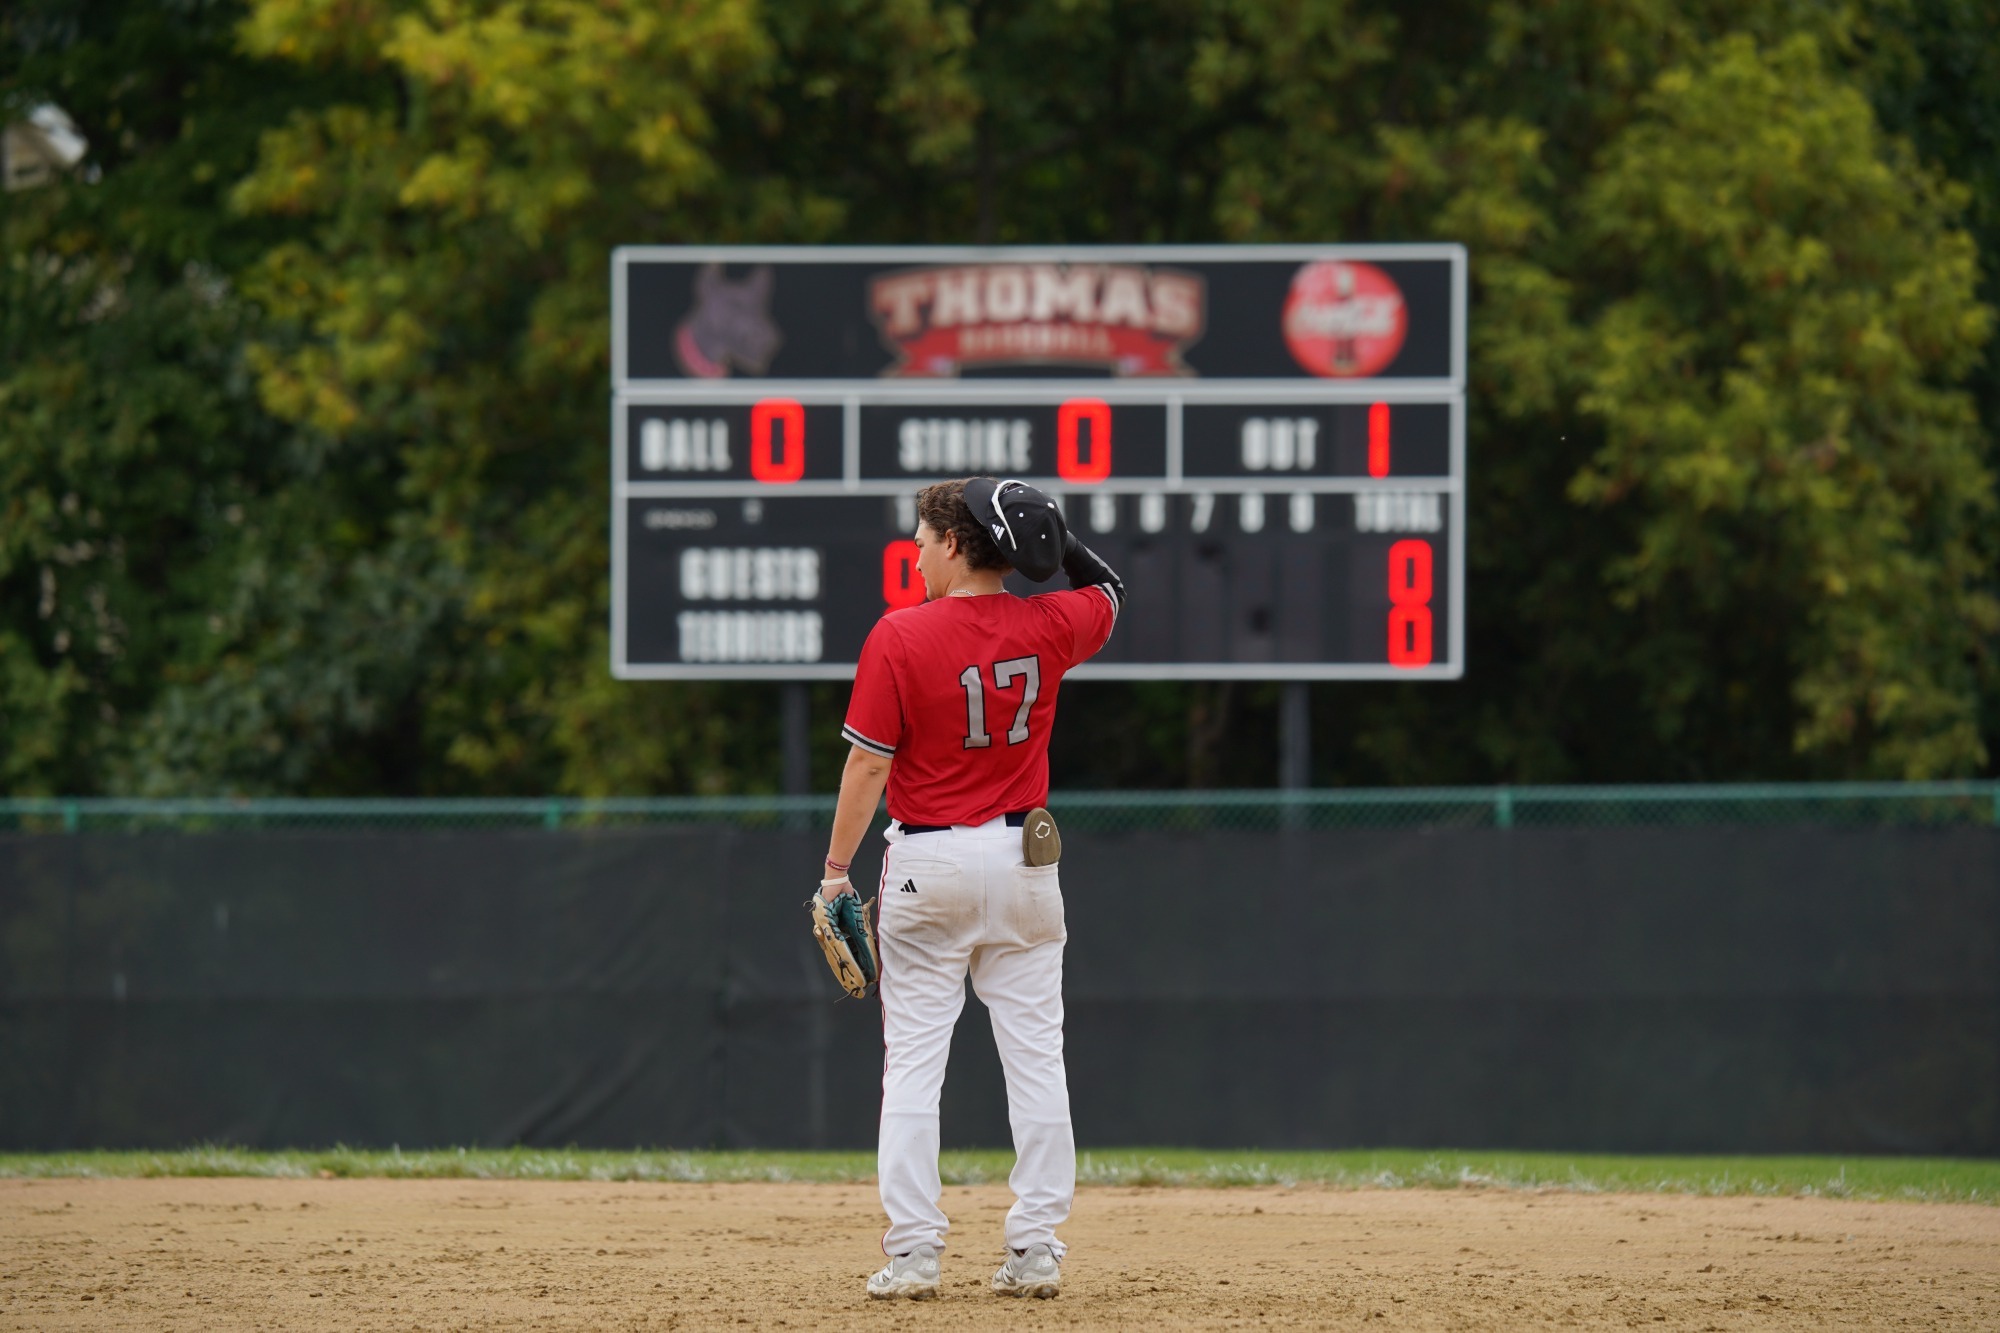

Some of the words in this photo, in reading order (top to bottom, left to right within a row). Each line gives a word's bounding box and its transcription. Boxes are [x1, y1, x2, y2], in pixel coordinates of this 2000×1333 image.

[873, 265, 1202, 337] THOMAS
[640, 417, 732, 472] BALL
[751, 398, 804, 483] 0
[899, 417, 1031, 472] STRIKE
[1058, 398, 1111, 483] 0
[1241, 417, 1319, 471] OUT
[1368, 401, 1390, 479] 1
[1191, 491, 1215, 533] 7
[1354, 491, 1442, 533] TOTAL
[680, 547, 820, 601] GUESTS
[1388, 539, 1433, 606] 0
[677, 610, 823, 664] TERRIERS
[1388, 603, 1433, 668] 0
[958, 653, 1042, 751] 17
